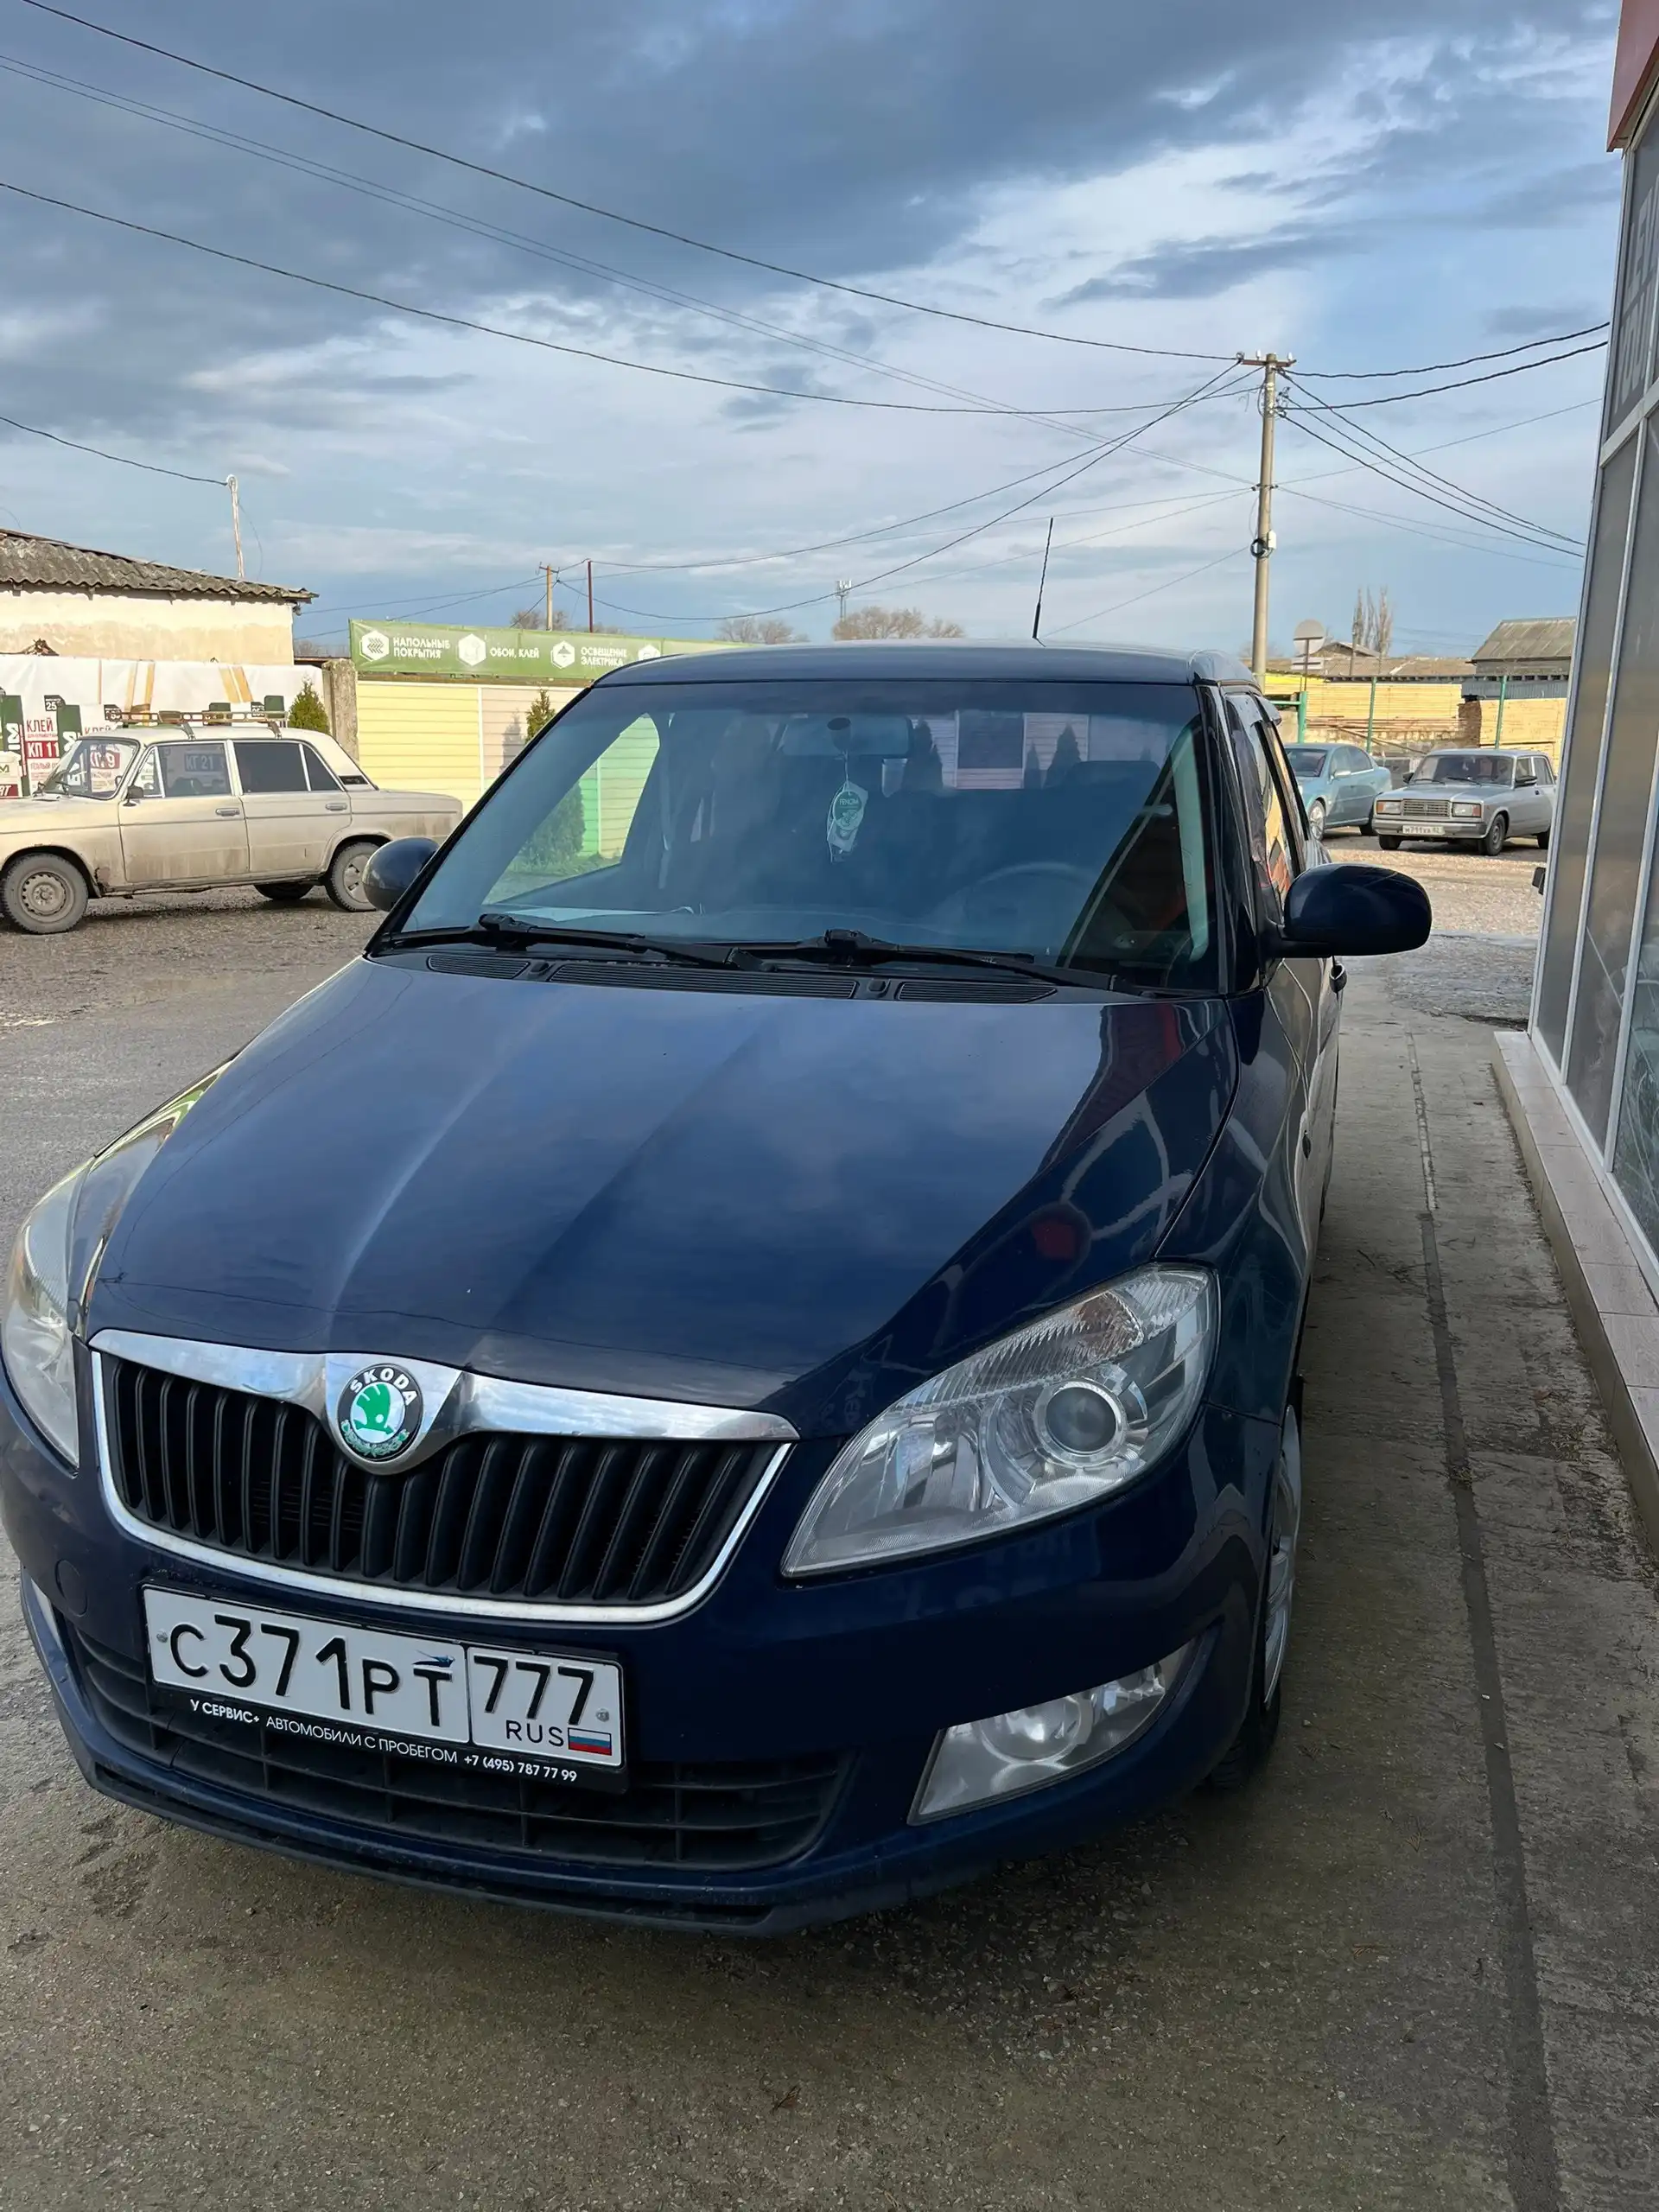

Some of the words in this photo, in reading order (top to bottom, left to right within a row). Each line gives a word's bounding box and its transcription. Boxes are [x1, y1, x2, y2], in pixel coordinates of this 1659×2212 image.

[393, 637, 450, 650] НАПОЛЬНЫЕ
[393, 647, 442, 658] ПОКРЫТИЯ
[489, 647, 517, 659] ОБОИ,
[518, 647, 539, 658] КЛЕЙ
[580, 646, 627, 658] ОСВЕЩЕНИЕ
[581, 658, 624, 667] ЭЛЕКТРИКА
[26, 717, 54, 733] КЛЕЙ
[27, 742, 43, 758] КП
[47, 742, 60, 758] 11
[185, 755, 199, 770] КГ
[201, 754, 214, 770] 21
[350, 1368, 418, 1406] SKODA
[170, 1614, 453, 1726] С371РТ
[474, 1655, 594, 1726] 777
[505, 1719, 564, 1747] RUS
[202, 1702, 260, 1724] СЕРВИС+
[266, 1716, 361, 1746] АВТОМОБИЛИ
[364, 1736, 376, 1749] С
[378, 1738, 458, 1764] ПРОБЕГОМ
[464, 1755, 480, 1766] +7
[482, 1757, 515, 1773] (495)
[518, 1762, 540, 1777] 787
[543, 1766, 558, 1779] 77
[561, 1769, 577, 1783] 99
